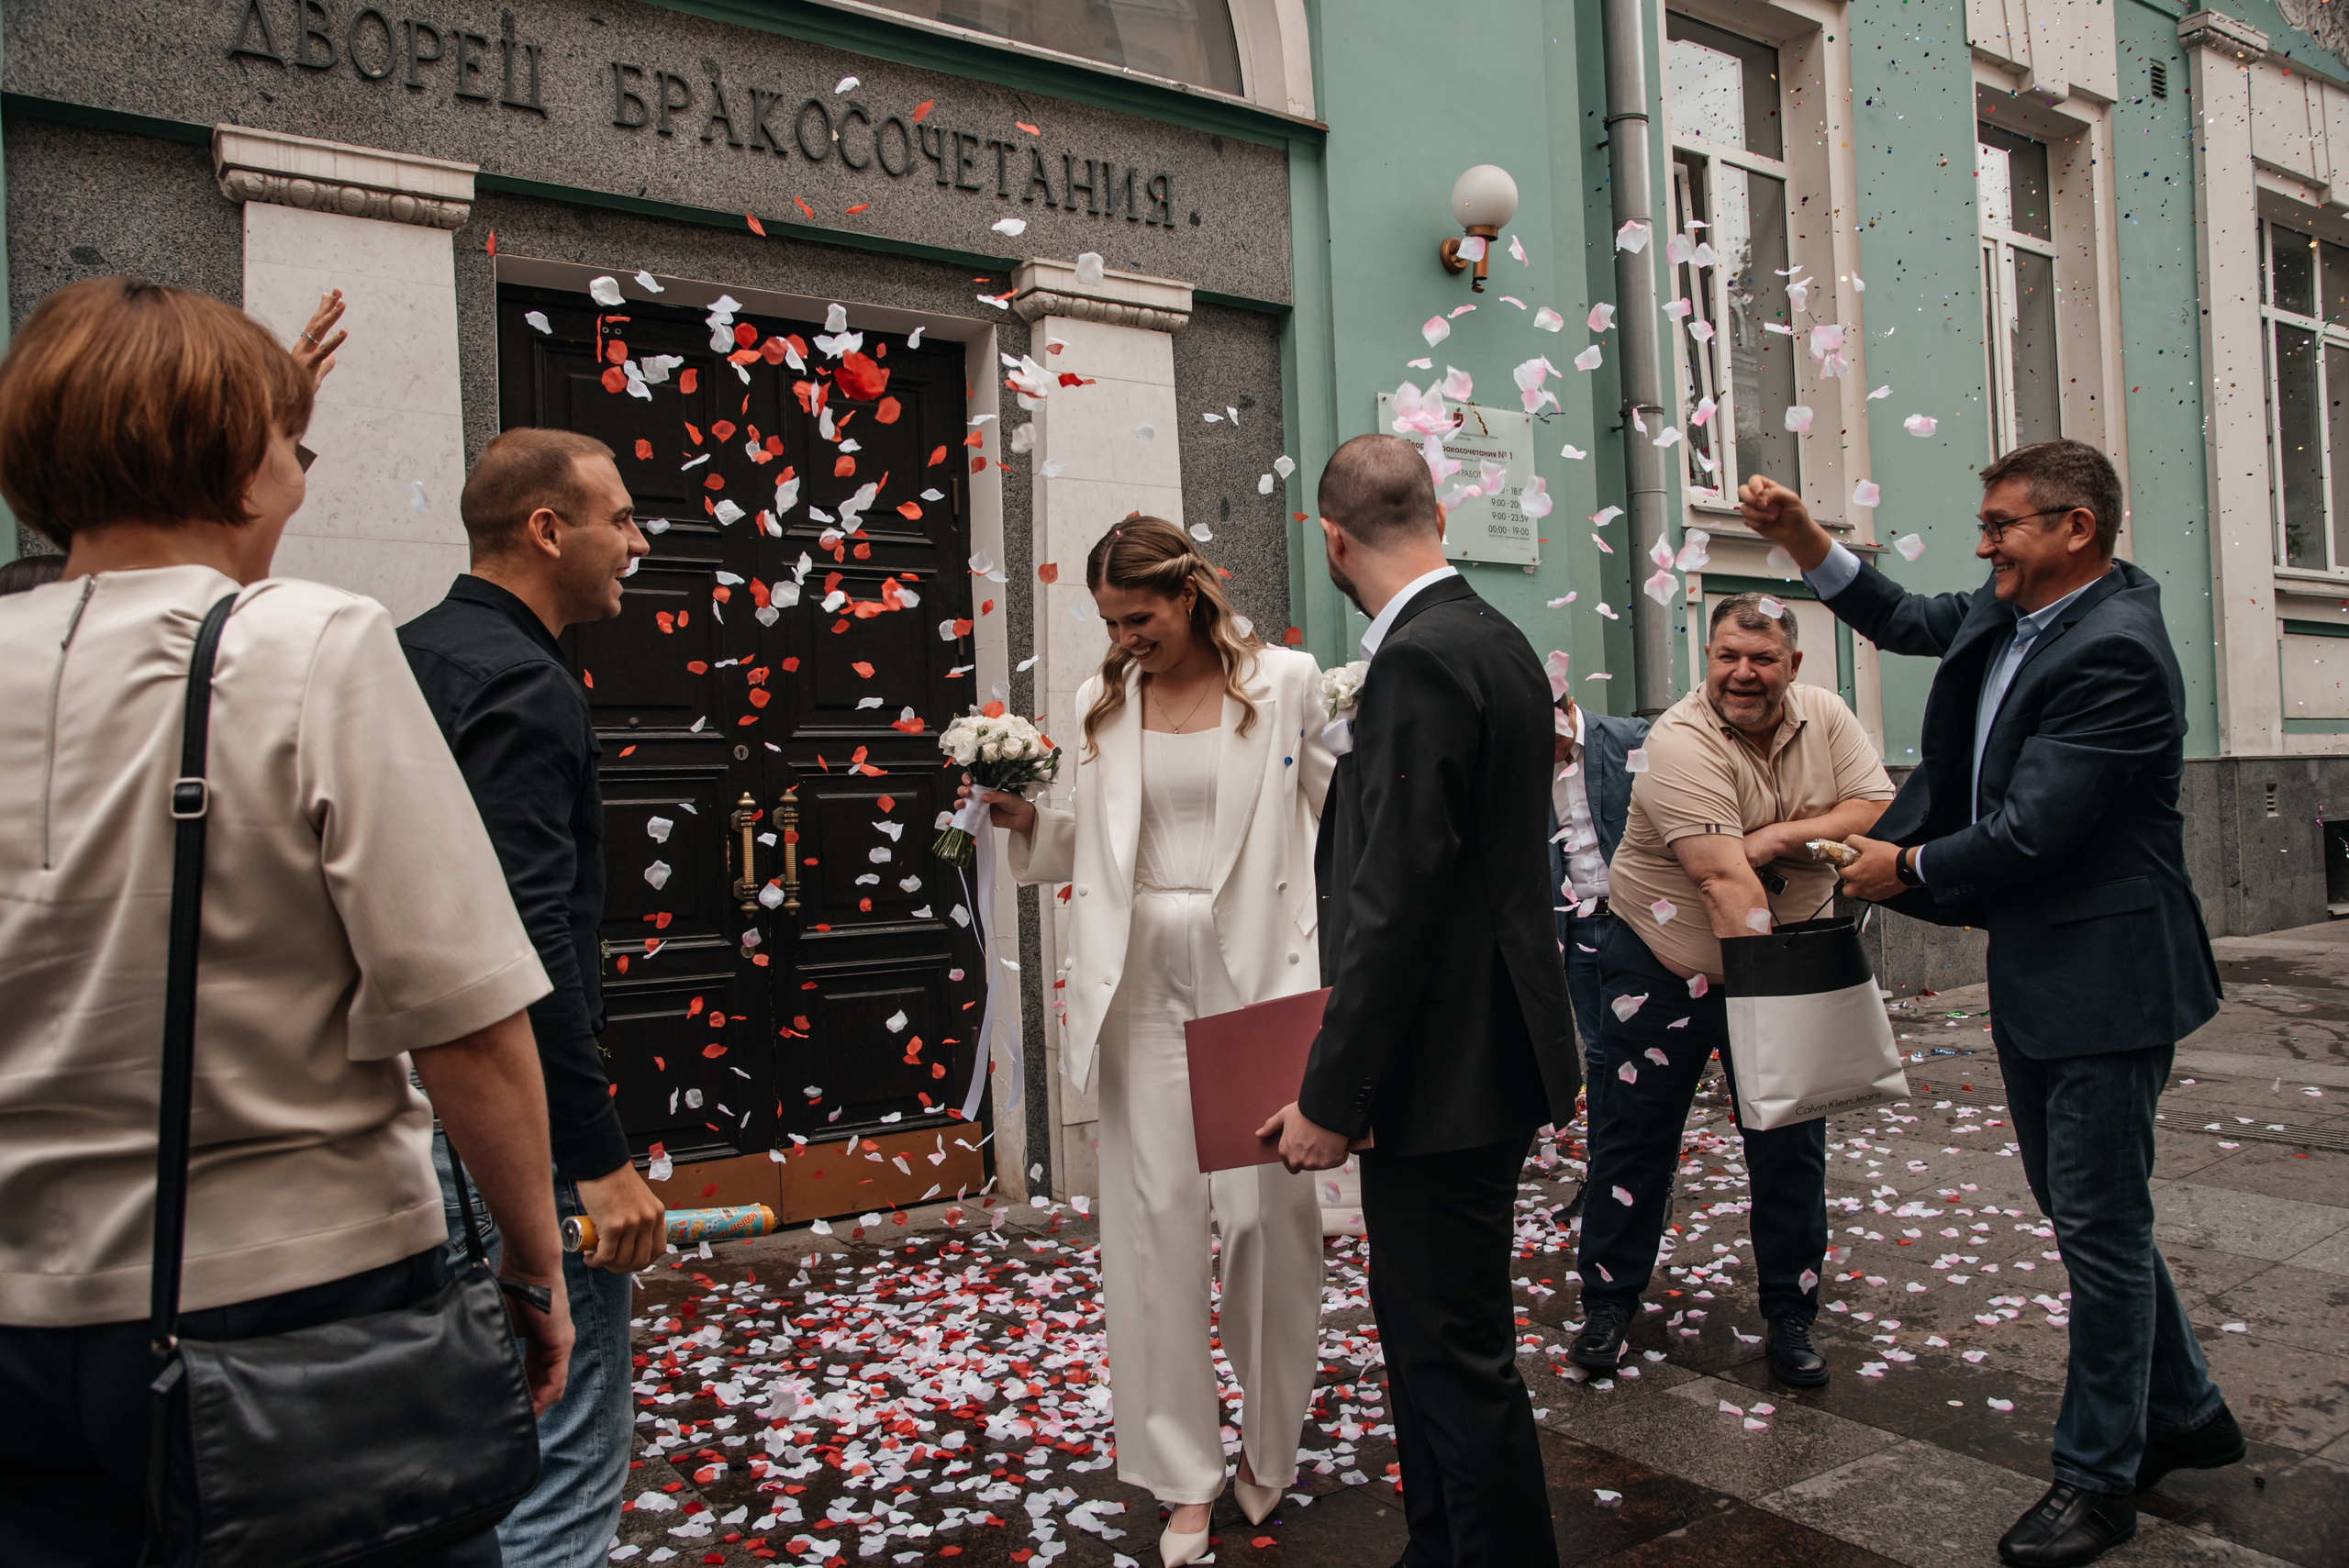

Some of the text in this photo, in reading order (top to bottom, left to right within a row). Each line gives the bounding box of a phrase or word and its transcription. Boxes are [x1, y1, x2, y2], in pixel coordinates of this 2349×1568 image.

[227, 0, 1175, 228] ДВОРЕЦ БРАКОСОЧЕТАНИЯ
[1442, 445, 1497, 459] ракосочетания
[1461, 469, 1482, 479] РАБОТ
[1510, 486, 1523, 495] 18:0
[1491, 498, 1506, 507] 9:00
[1491, 511, 1507, 520] 9:00
[1510, 513, 1529, 523] 23:59
[1487, 525, 1507, 534] 00:00
[1512, 527, 1530, 536] 19:00
[1795, 1091, 1882, 1117] Calvin Klein Jeans
